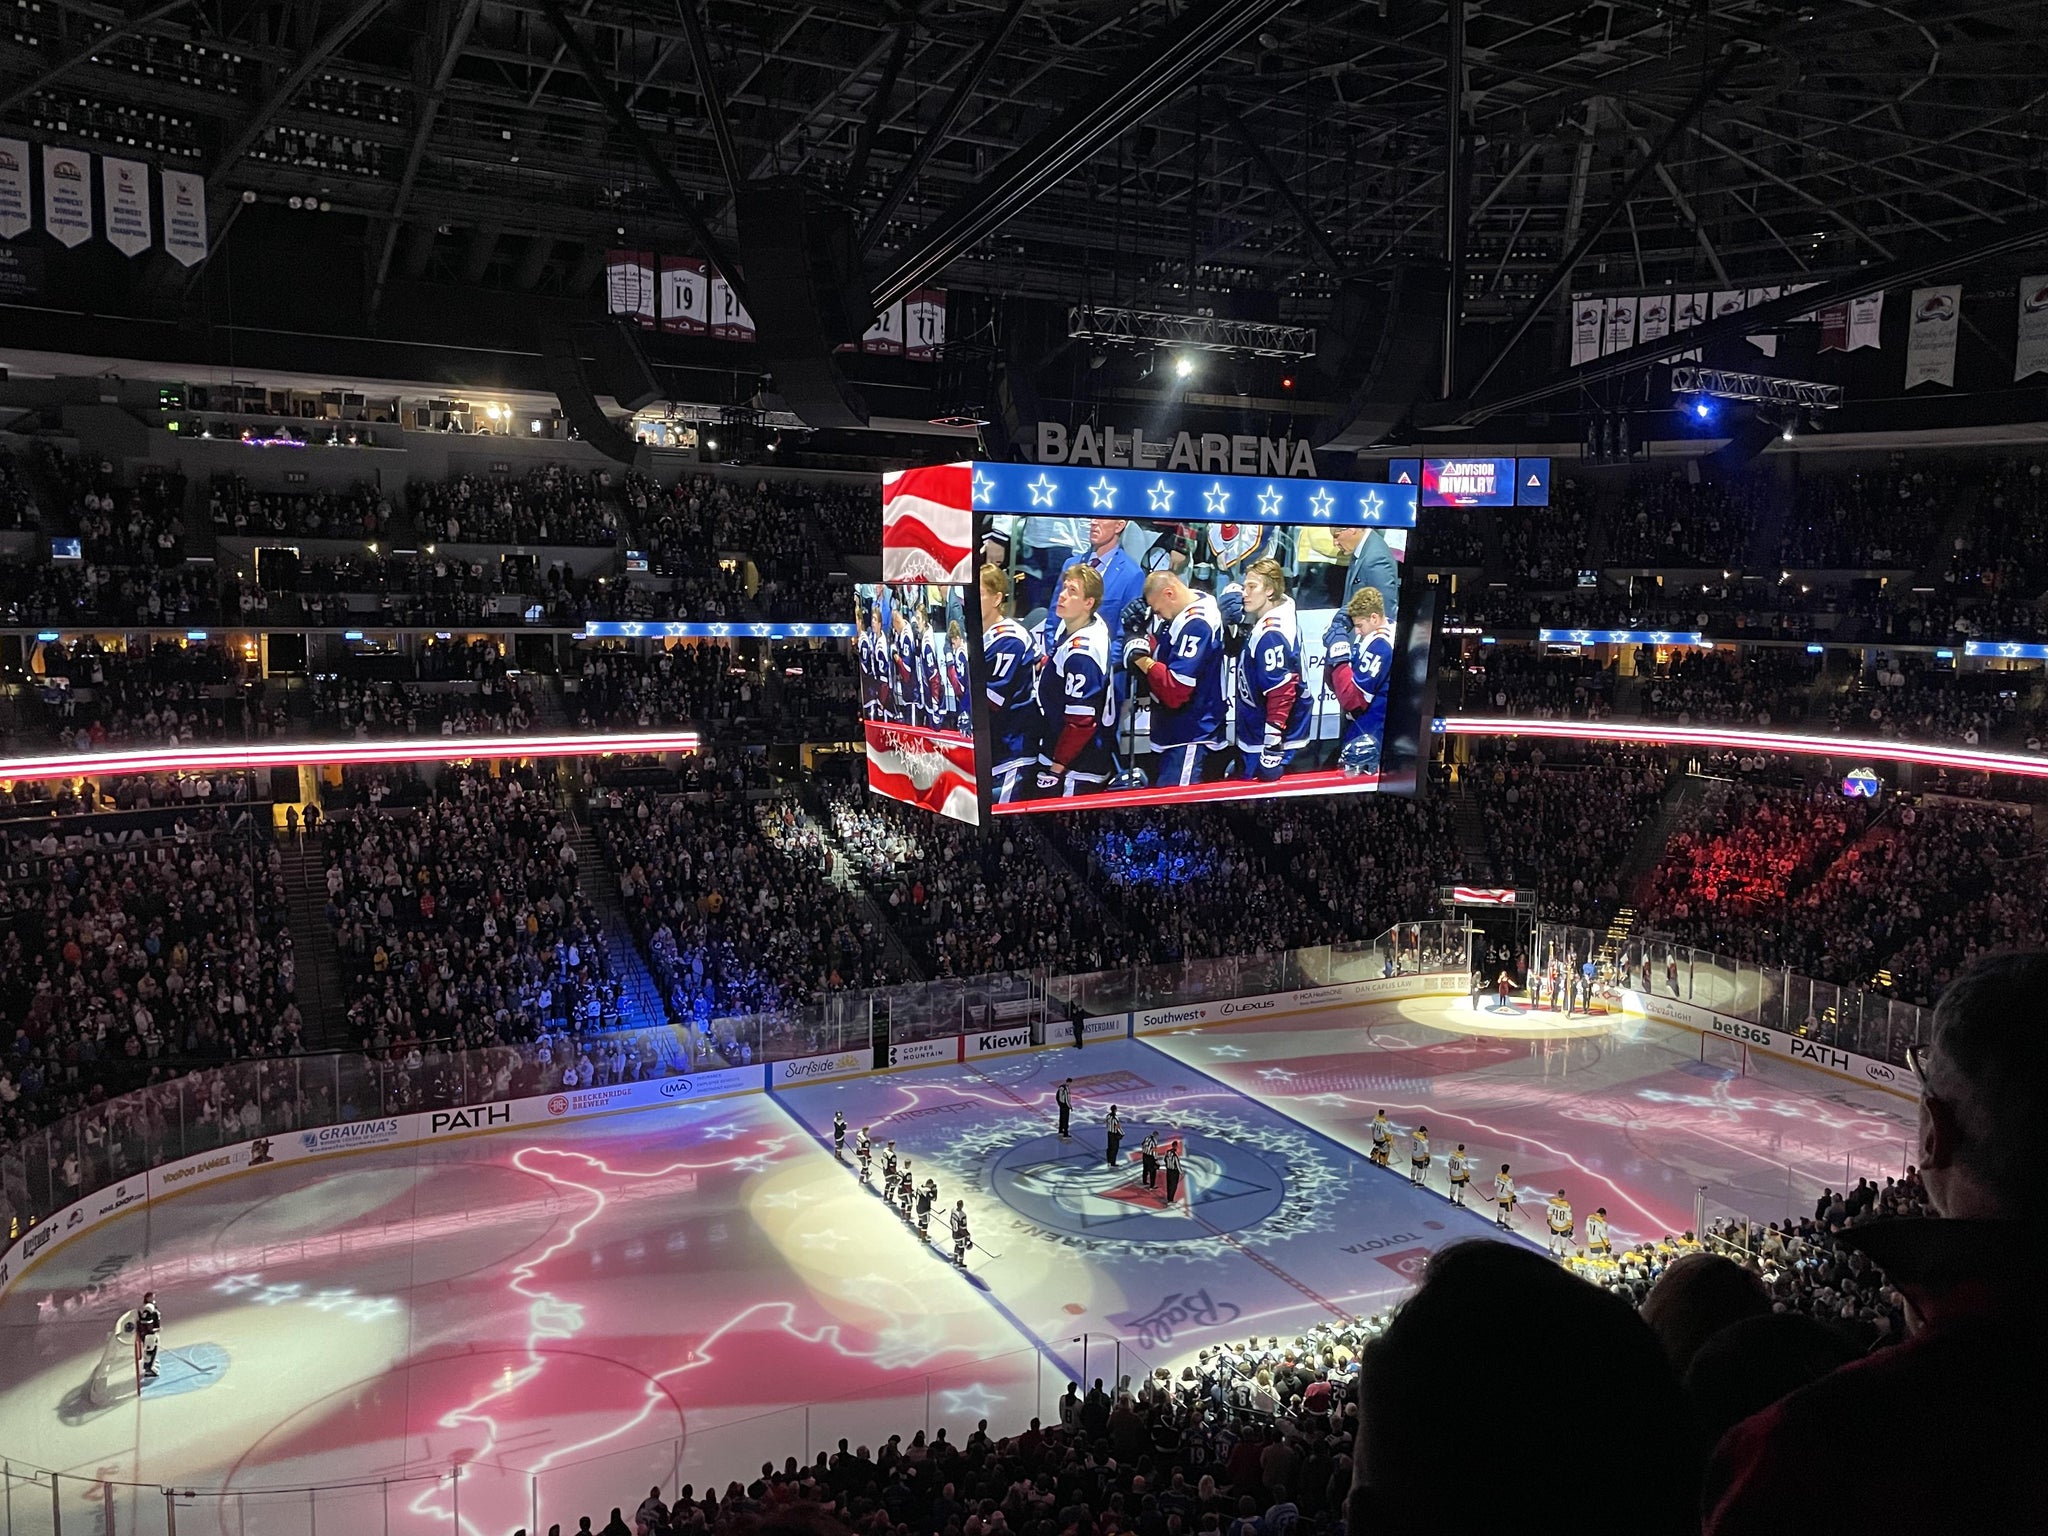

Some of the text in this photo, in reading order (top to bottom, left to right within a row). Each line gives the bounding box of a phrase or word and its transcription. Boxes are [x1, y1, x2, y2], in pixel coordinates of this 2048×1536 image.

[675, 285, 693, 310] 19
[725, 292, 740, 317] 21
[1037, 421, 1318, 477] BALL ARENA
[1455, 463, 1495, 476] DIVISION
[1439, 476, 1496, 494] RIVALRY
[1178, 634, 1201, 658] 13
[992, 652, 1015, 677] 17
[1264, 644, 1284, 672] 93
[1309, 655, 1325, 669] PA
[1359, 650, 1382, 678] 54
[1065, 672, 1086, 698] 82
[1236, 1000, 1275, 1012] LEXUS
[1670, 1011, 1692, 1022] LIGHT
[1083, 1020, 1115, 1034] MSTERDAM
[1144, 1009, 1199, 1026] Southwest
[979, 1031, 1030, 1051] Kiewi
[1713, 1016, 1771, 1046] bet365
[903, 1044, 933, 1054] COPPER
[903, 1050, 943, 1061] MOUNTAIN
[1790, 1038, 1849, 1071] PATH
[785, 1058, 834, 1078] Surfside
[1870, 1066, 1890, 1080] IMA
[572, 1088, 632, 1103] BRECKENRIDGE
[665, 1083, 688, 1093] IMA
[572, 1099, 610, 1110] BREWERY
[432, 1103, 510, 1133] PATH
[319, 1119, 398, 1141] GRAVINA'S
[162, 1166, 196, 1184] VOODOO
[197, 1155, 231, 1174] RANGER
[1011, 1220, 1103, 1251] ARENA
[1339, 1232, 1424, 1254] TOYOTA
[1124, 1287, 1241, 1350] Ball
